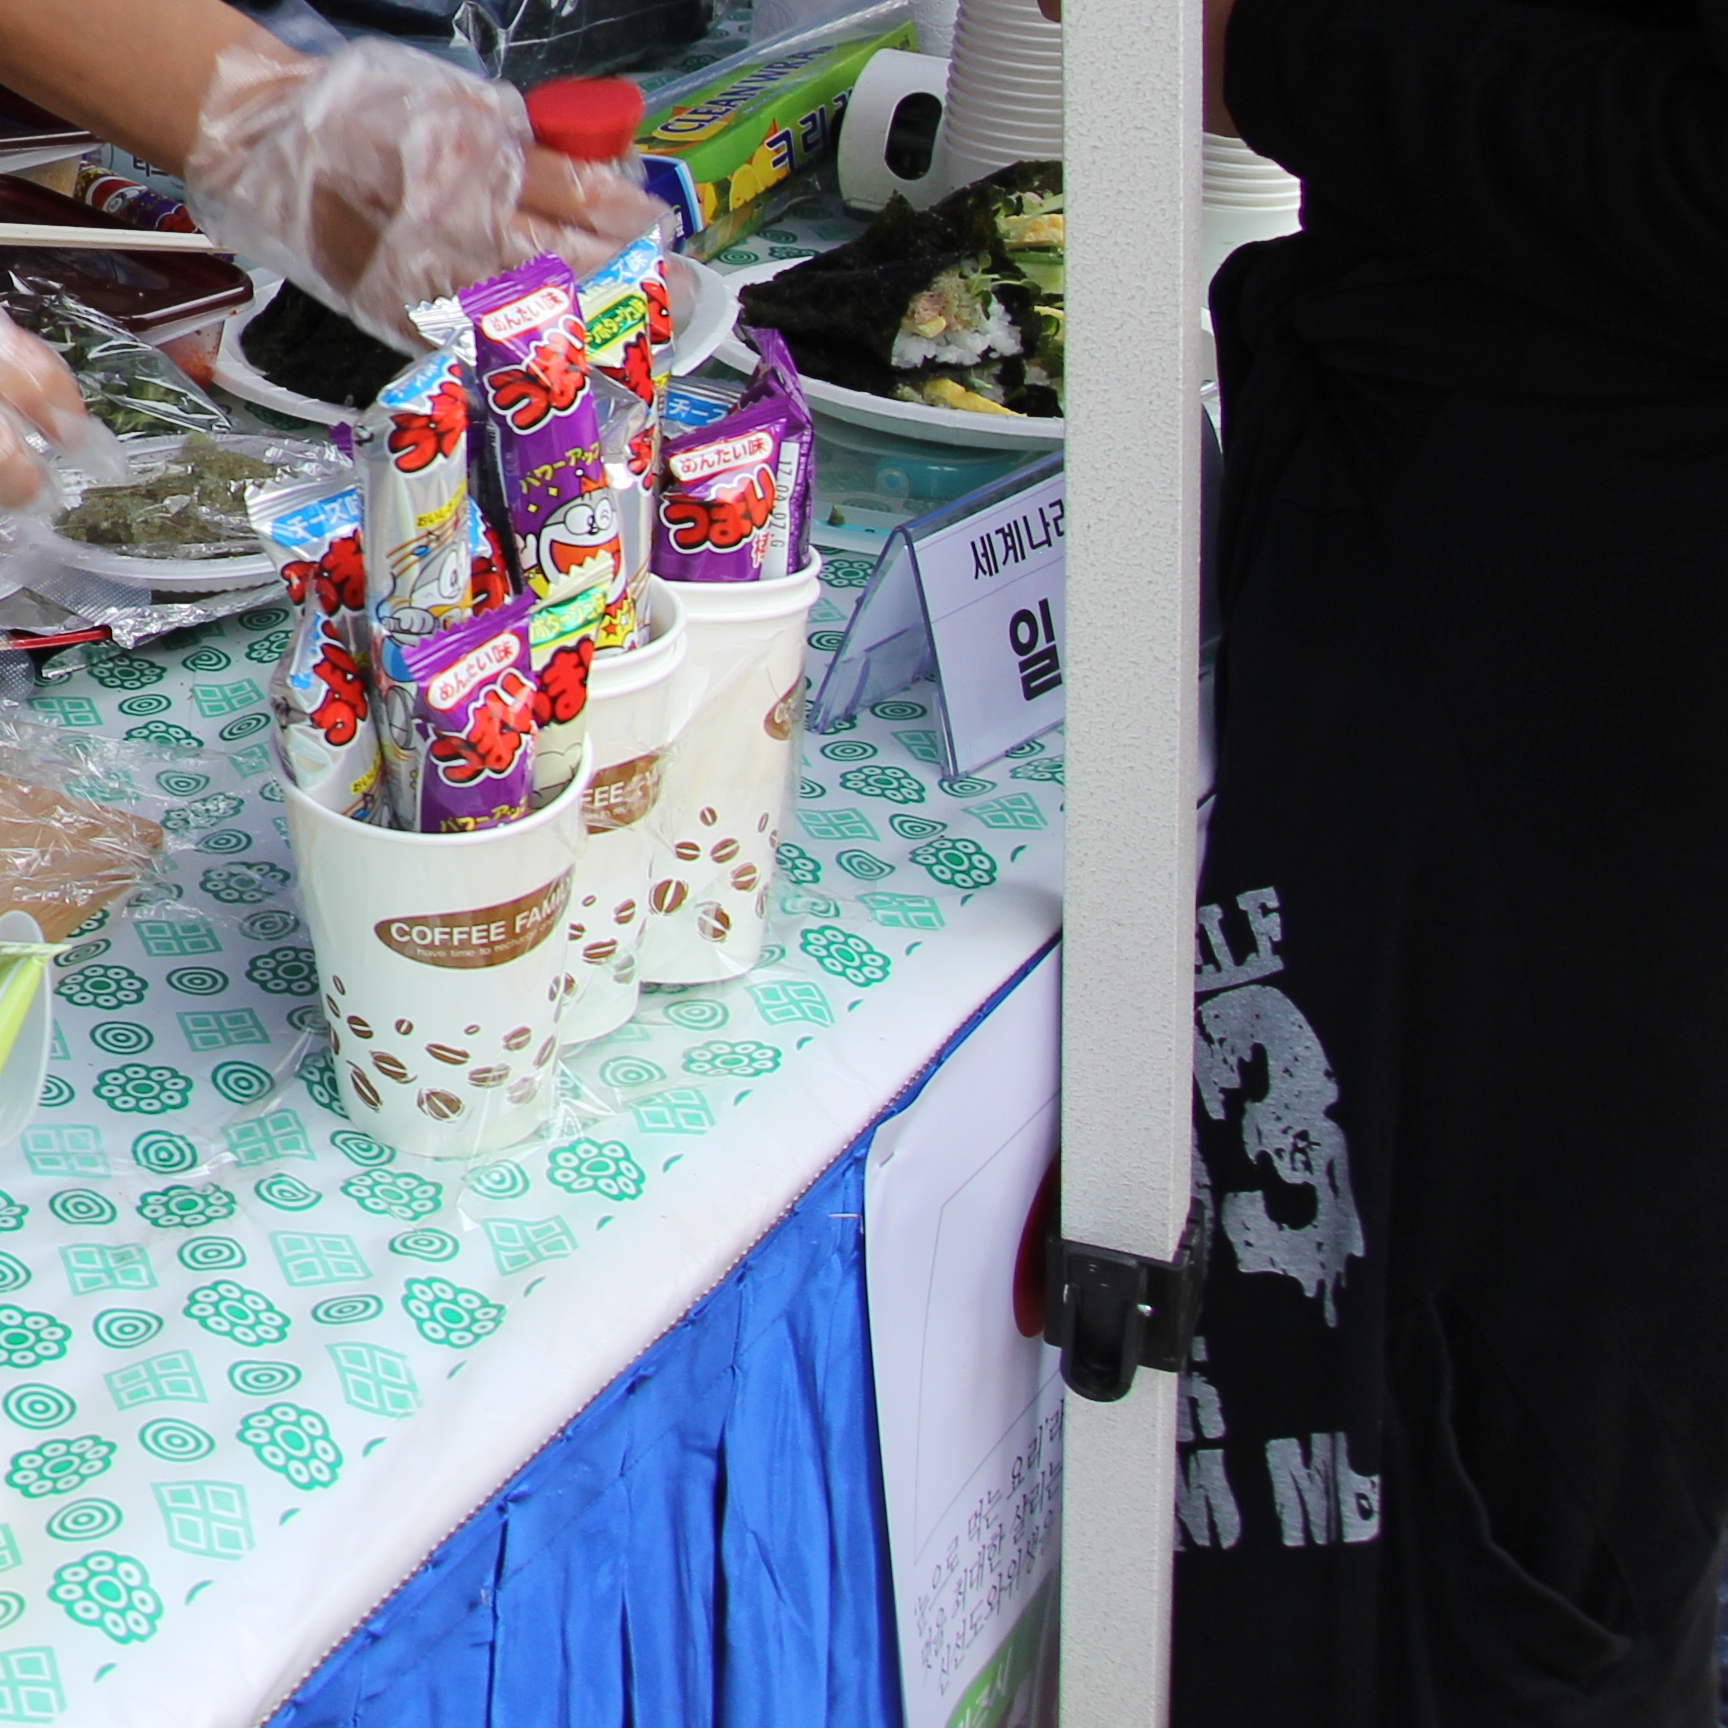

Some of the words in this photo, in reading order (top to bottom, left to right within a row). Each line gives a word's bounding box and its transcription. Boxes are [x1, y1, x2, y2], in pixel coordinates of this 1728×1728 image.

[680, 437, 768, 475] めんたい味
[438, 640, 516, 702] めんたい味
[389, 920, 507, 947] COFFEE
[967, 1488, 1003, 1544] 먹는
[951, 1523, 1005, 1619] 최대한
